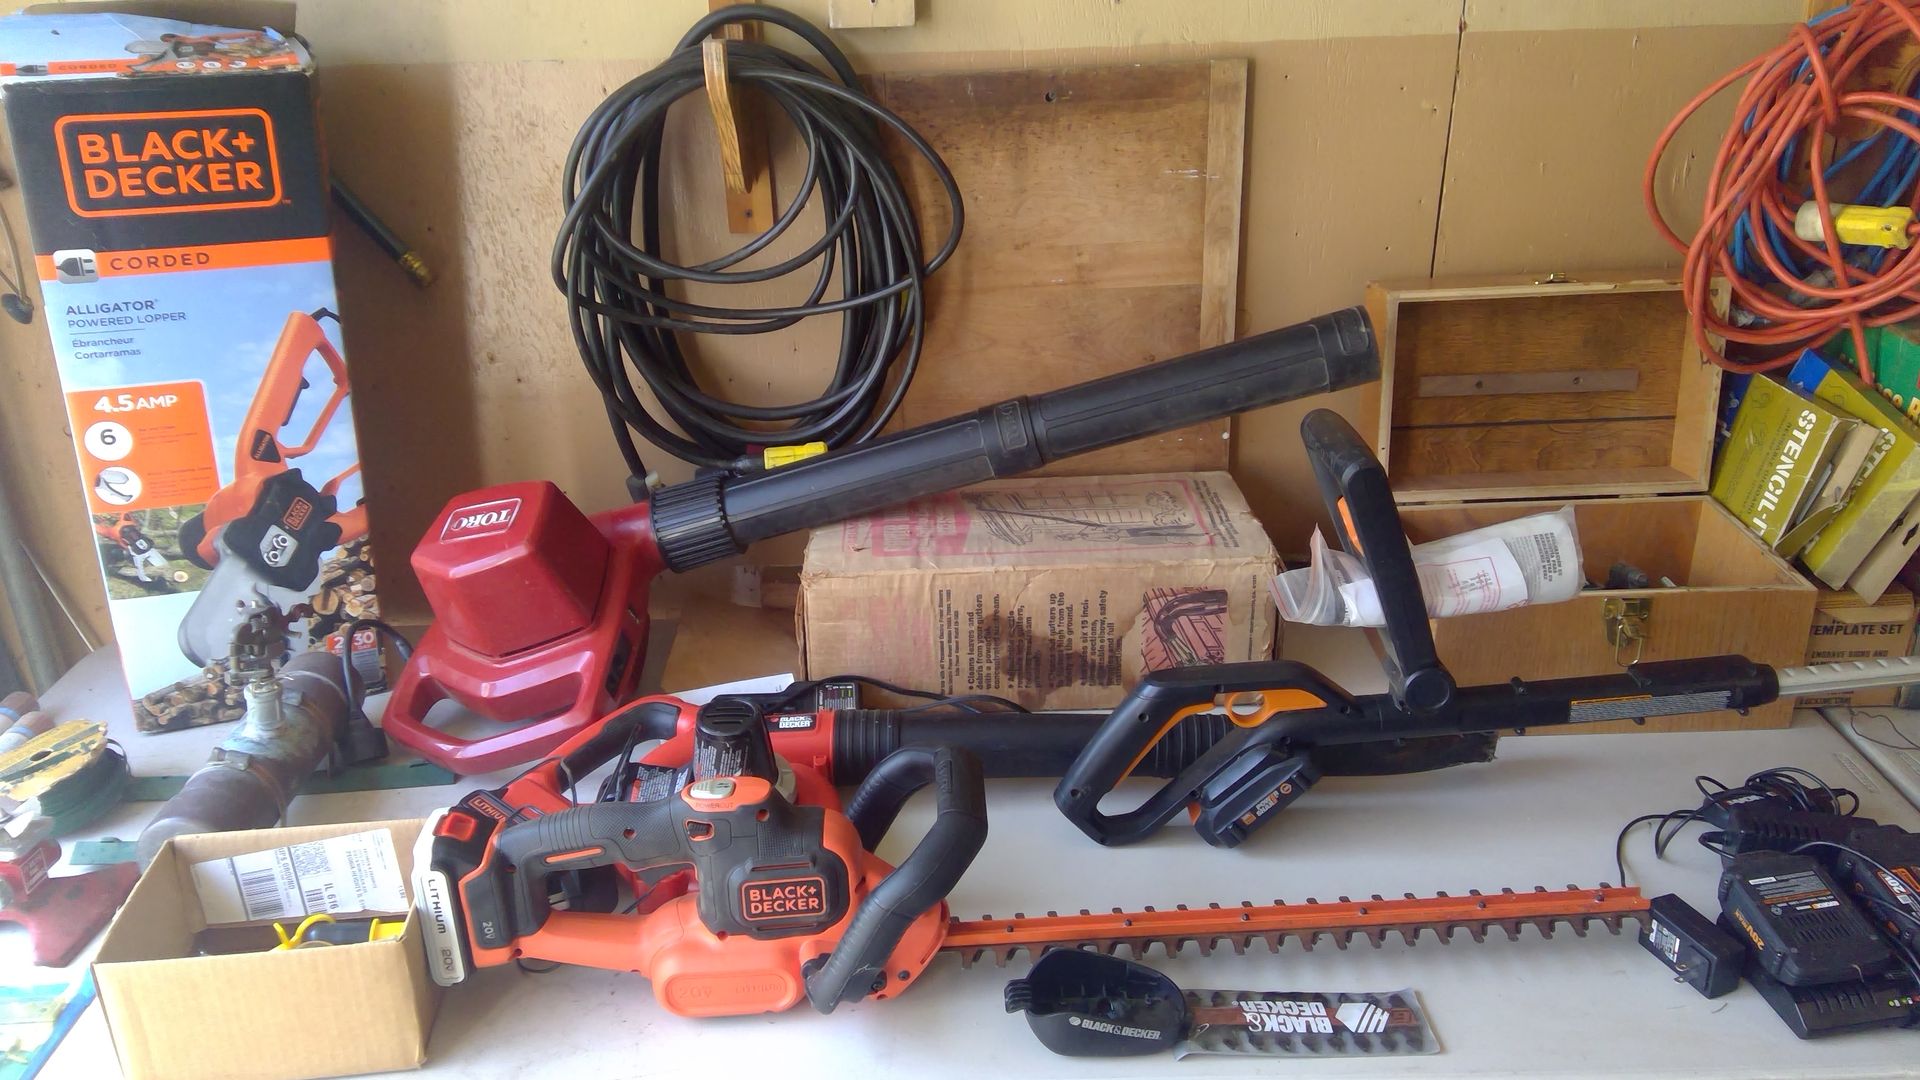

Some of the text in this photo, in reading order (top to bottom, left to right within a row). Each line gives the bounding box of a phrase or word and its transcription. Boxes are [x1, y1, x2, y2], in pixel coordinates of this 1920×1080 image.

[77, 128, 254, 164] BLACK+
[84, 161, 264, 199] DECKER
[111, 252, 210, 271] CORDED
[68, 311, 186, 328] POWERED LOPPER
[72, 336, 134, 348] Ébrancheur
[74, 348, 142, 360] Cortarramas
[94, 394, 178, 412] 4.5 AMP
[100, 428, 117, 446] 6
[450, 508, 511, 531] TORO
[1050, 594, 1056, 604] up
[1099, 590, 1107, 615] safety
[1081, 620, 1088, 629] 15
[1880, 624, 1904, 634] SET
[1090, 620, 1098, 655] sections,
[779, 720, 810, 728] DECKER
[324, 882, 339, 910] IL 616
[749, 885, 818, 904] BLACK+
[427, 877, 447, 935] LITHIUM
[750, 896, 820, 915] DECKER
[481, 920, 494, 940] 20V
[440, 946, 453, 976] 20V
